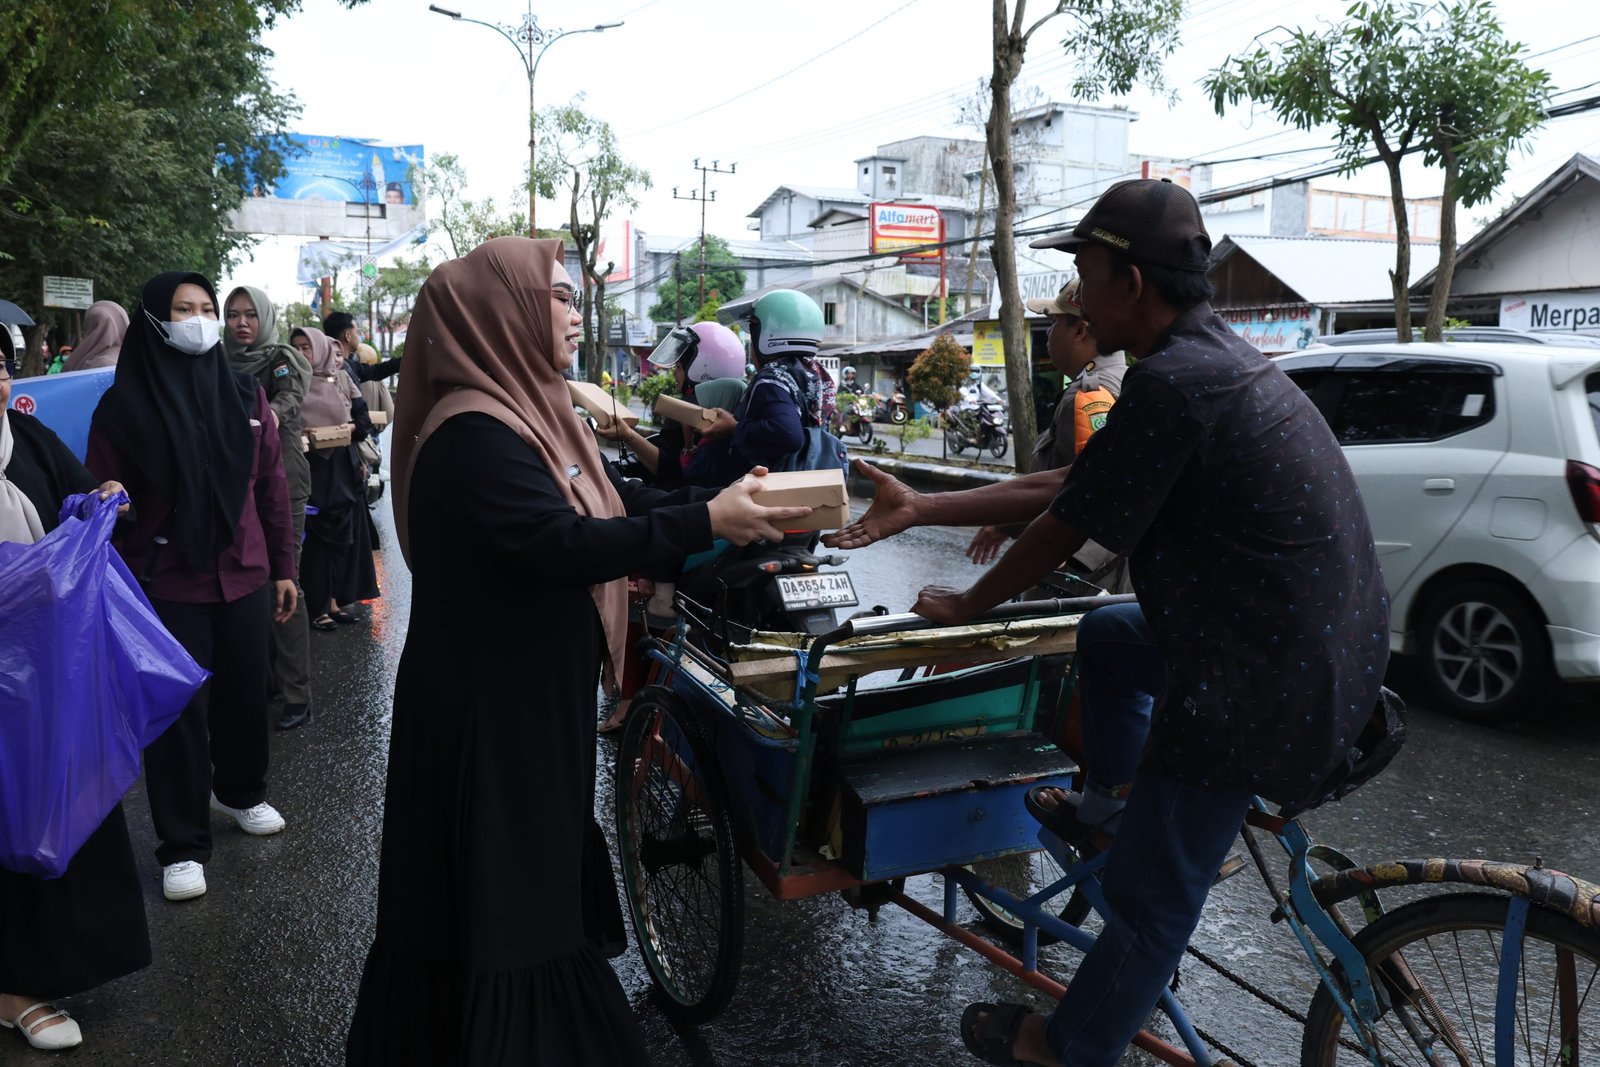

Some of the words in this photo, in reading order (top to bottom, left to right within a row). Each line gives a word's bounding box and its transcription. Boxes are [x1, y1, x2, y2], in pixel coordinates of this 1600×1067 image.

[878, 210, 936, 225] Alfamart
[1022, 274, 1057, 300] SINAR
[1531, 304, 1600, 331] Merpa
